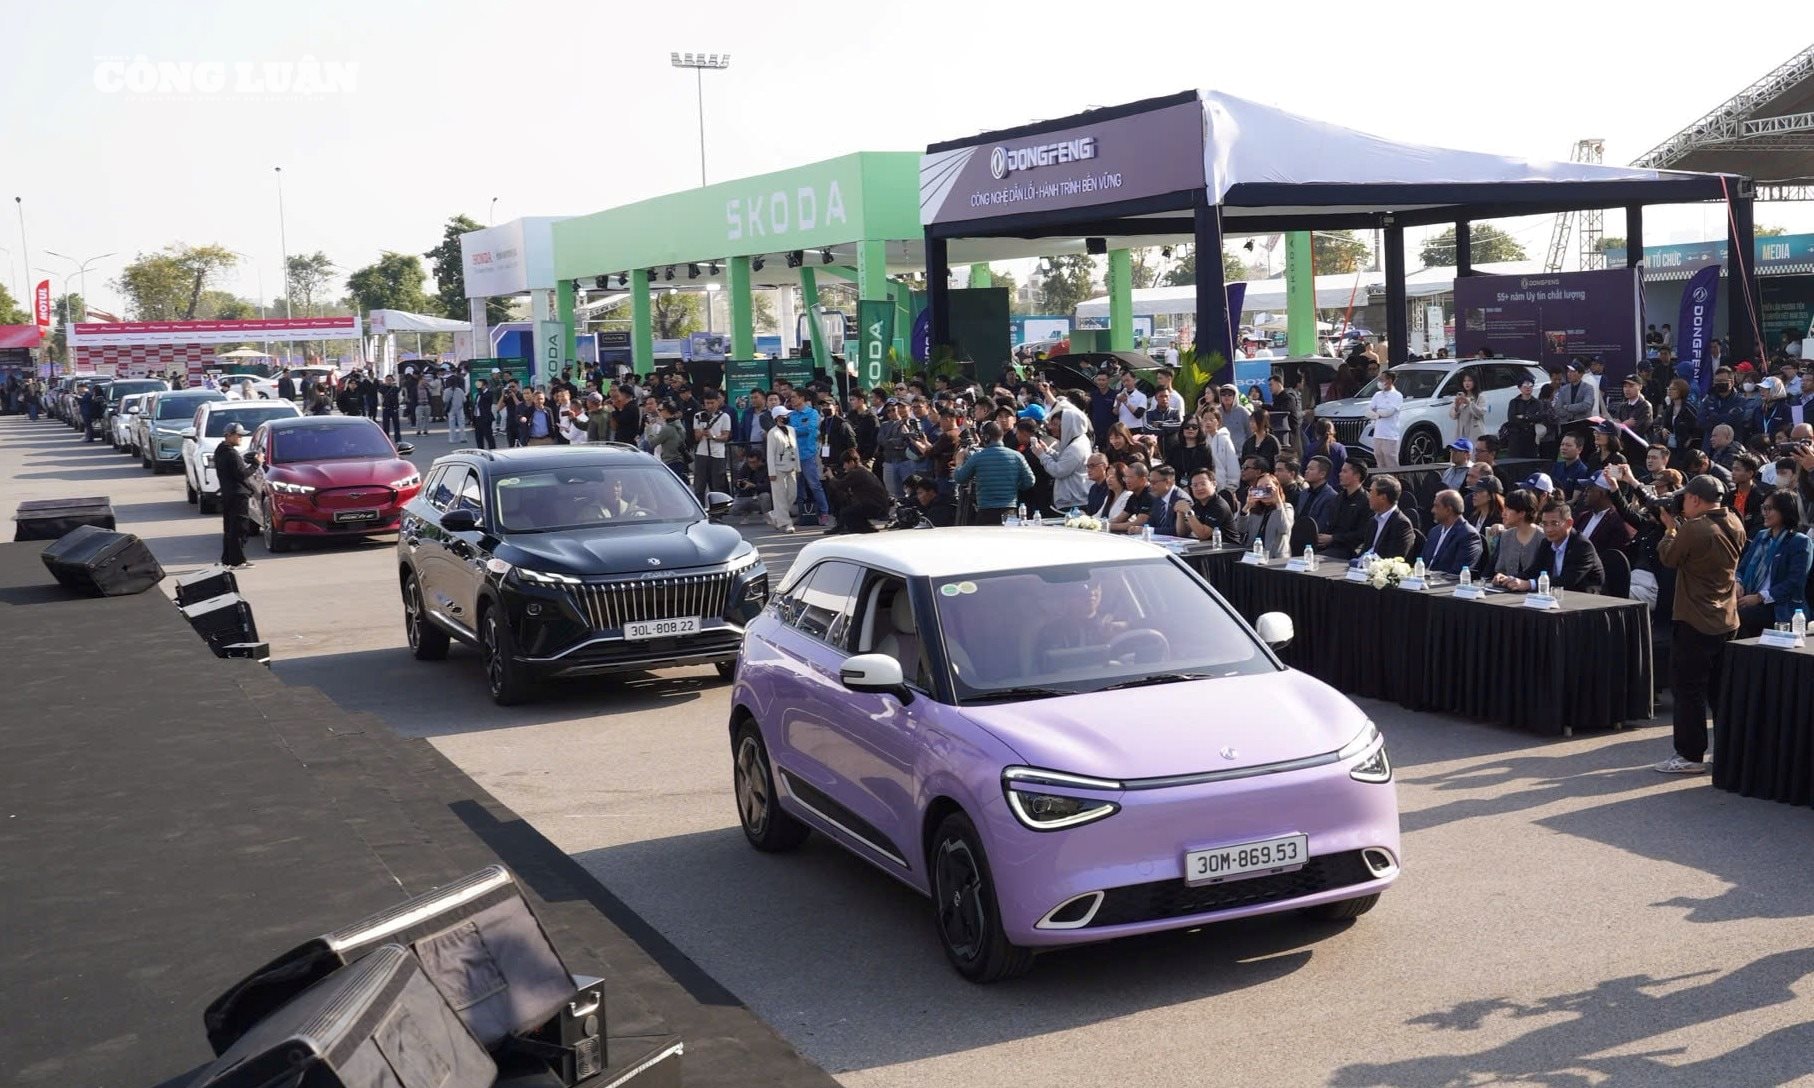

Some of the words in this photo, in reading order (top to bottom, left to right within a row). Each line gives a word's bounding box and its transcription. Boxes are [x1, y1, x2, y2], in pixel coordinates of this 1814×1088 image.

[1007, 137, 1095, 171] DONGFENG
[971, 191, 990, 207] CÔNG
[990, 187, 1008, 206] NGHỆ
[1039, 181, 1059, 198] HÀNH
[1060, 177, 1081, 195] TRÌNH
[726, 179, 847, 241] SKODA
[1762, 243, 1790, 261] MEDIA
[1692, 305, 1704, 383] DONGFEN
[631, 620, 694, 637] 30L-808.22
[1197, 842, 1298, 874] 30M-869.53
